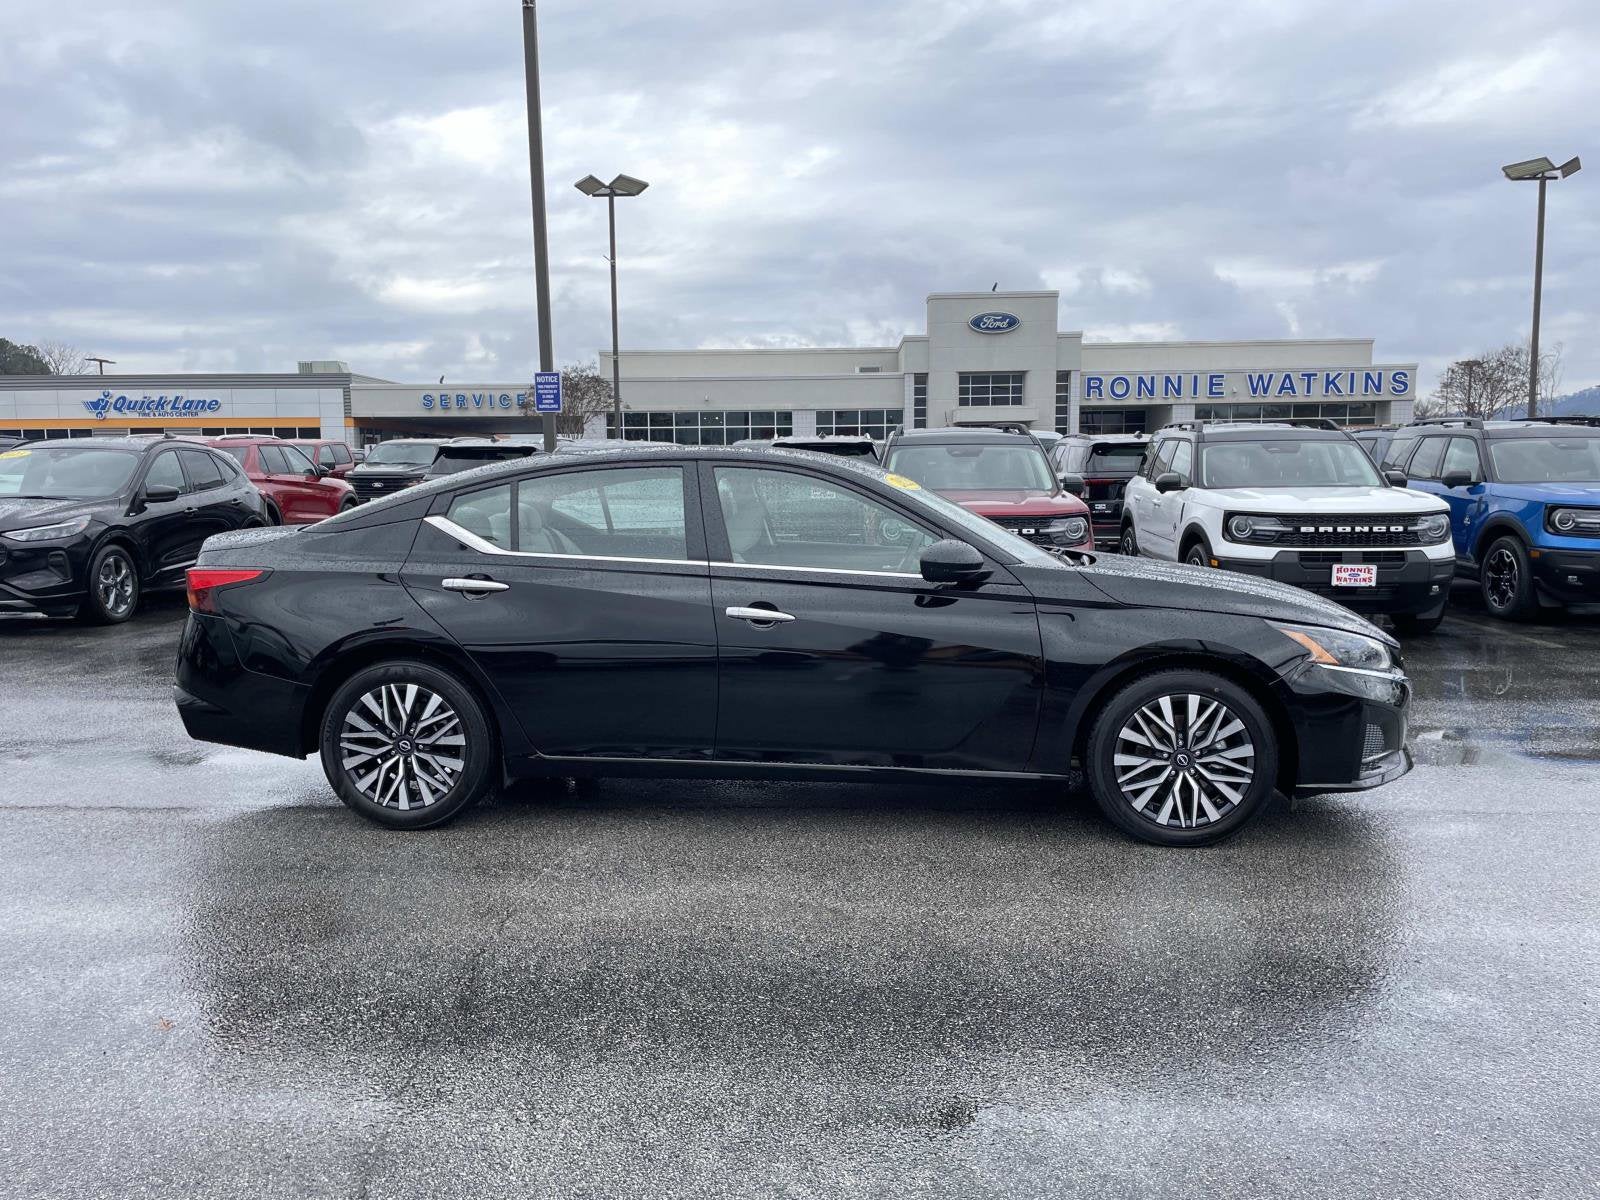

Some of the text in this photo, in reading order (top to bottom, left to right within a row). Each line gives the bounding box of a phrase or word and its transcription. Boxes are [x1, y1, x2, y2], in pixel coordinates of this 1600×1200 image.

[980, 316, 1010, 328] Ford
[1085, 371, 1410, 399] RONNIE WATKINS
[112, 396, 220, 412] Quick Lane
[422, 394, 526, 409] SERVICE
[1336, 567, 1373, 575] RONNIE
